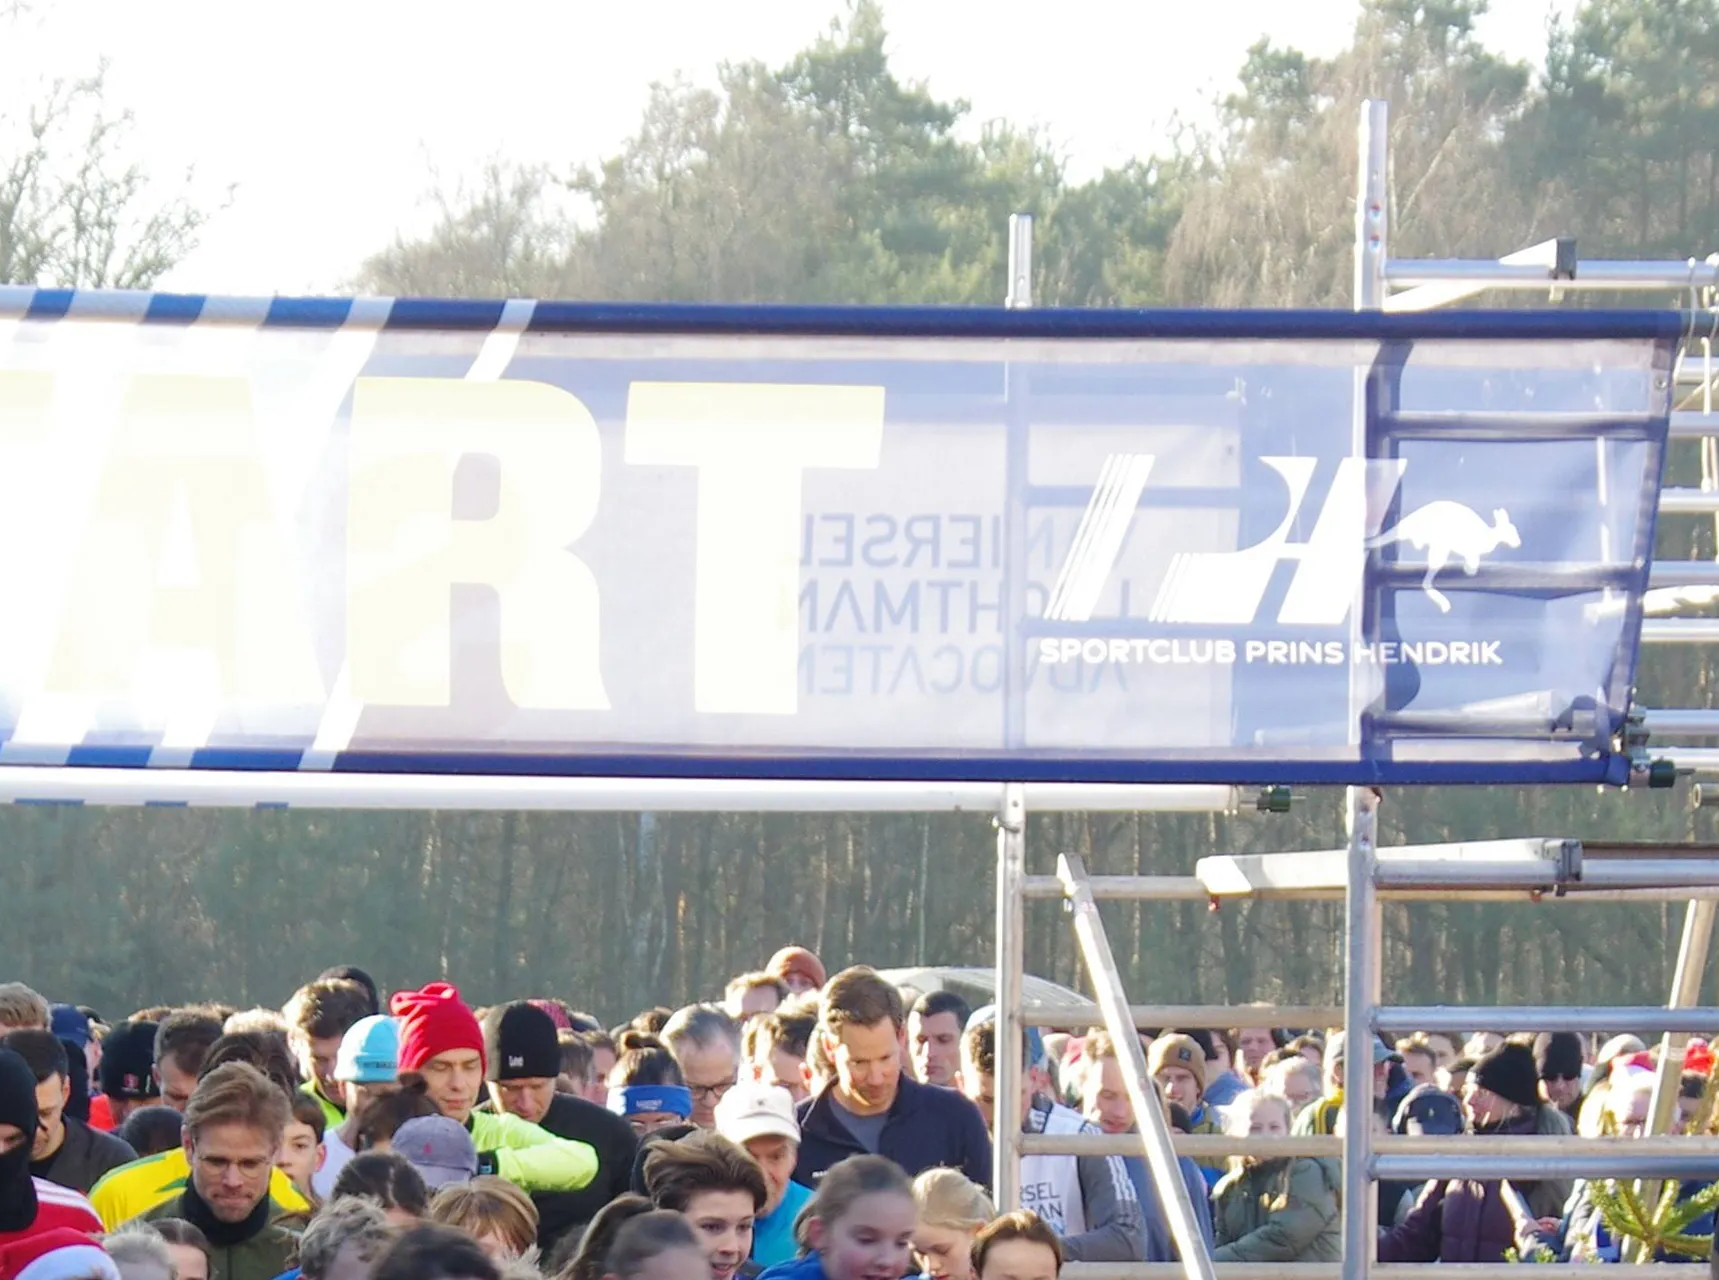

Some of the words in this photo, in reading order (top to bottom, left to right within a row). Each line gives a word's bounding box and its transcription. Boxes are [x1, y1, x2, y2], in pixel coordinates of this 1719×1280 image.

[1039, 637, 1237, 665] SPORTCLUB
[1245, 638, 1344, 665] PRINS
[1354, 639, 1504, 666] HENDRIK
